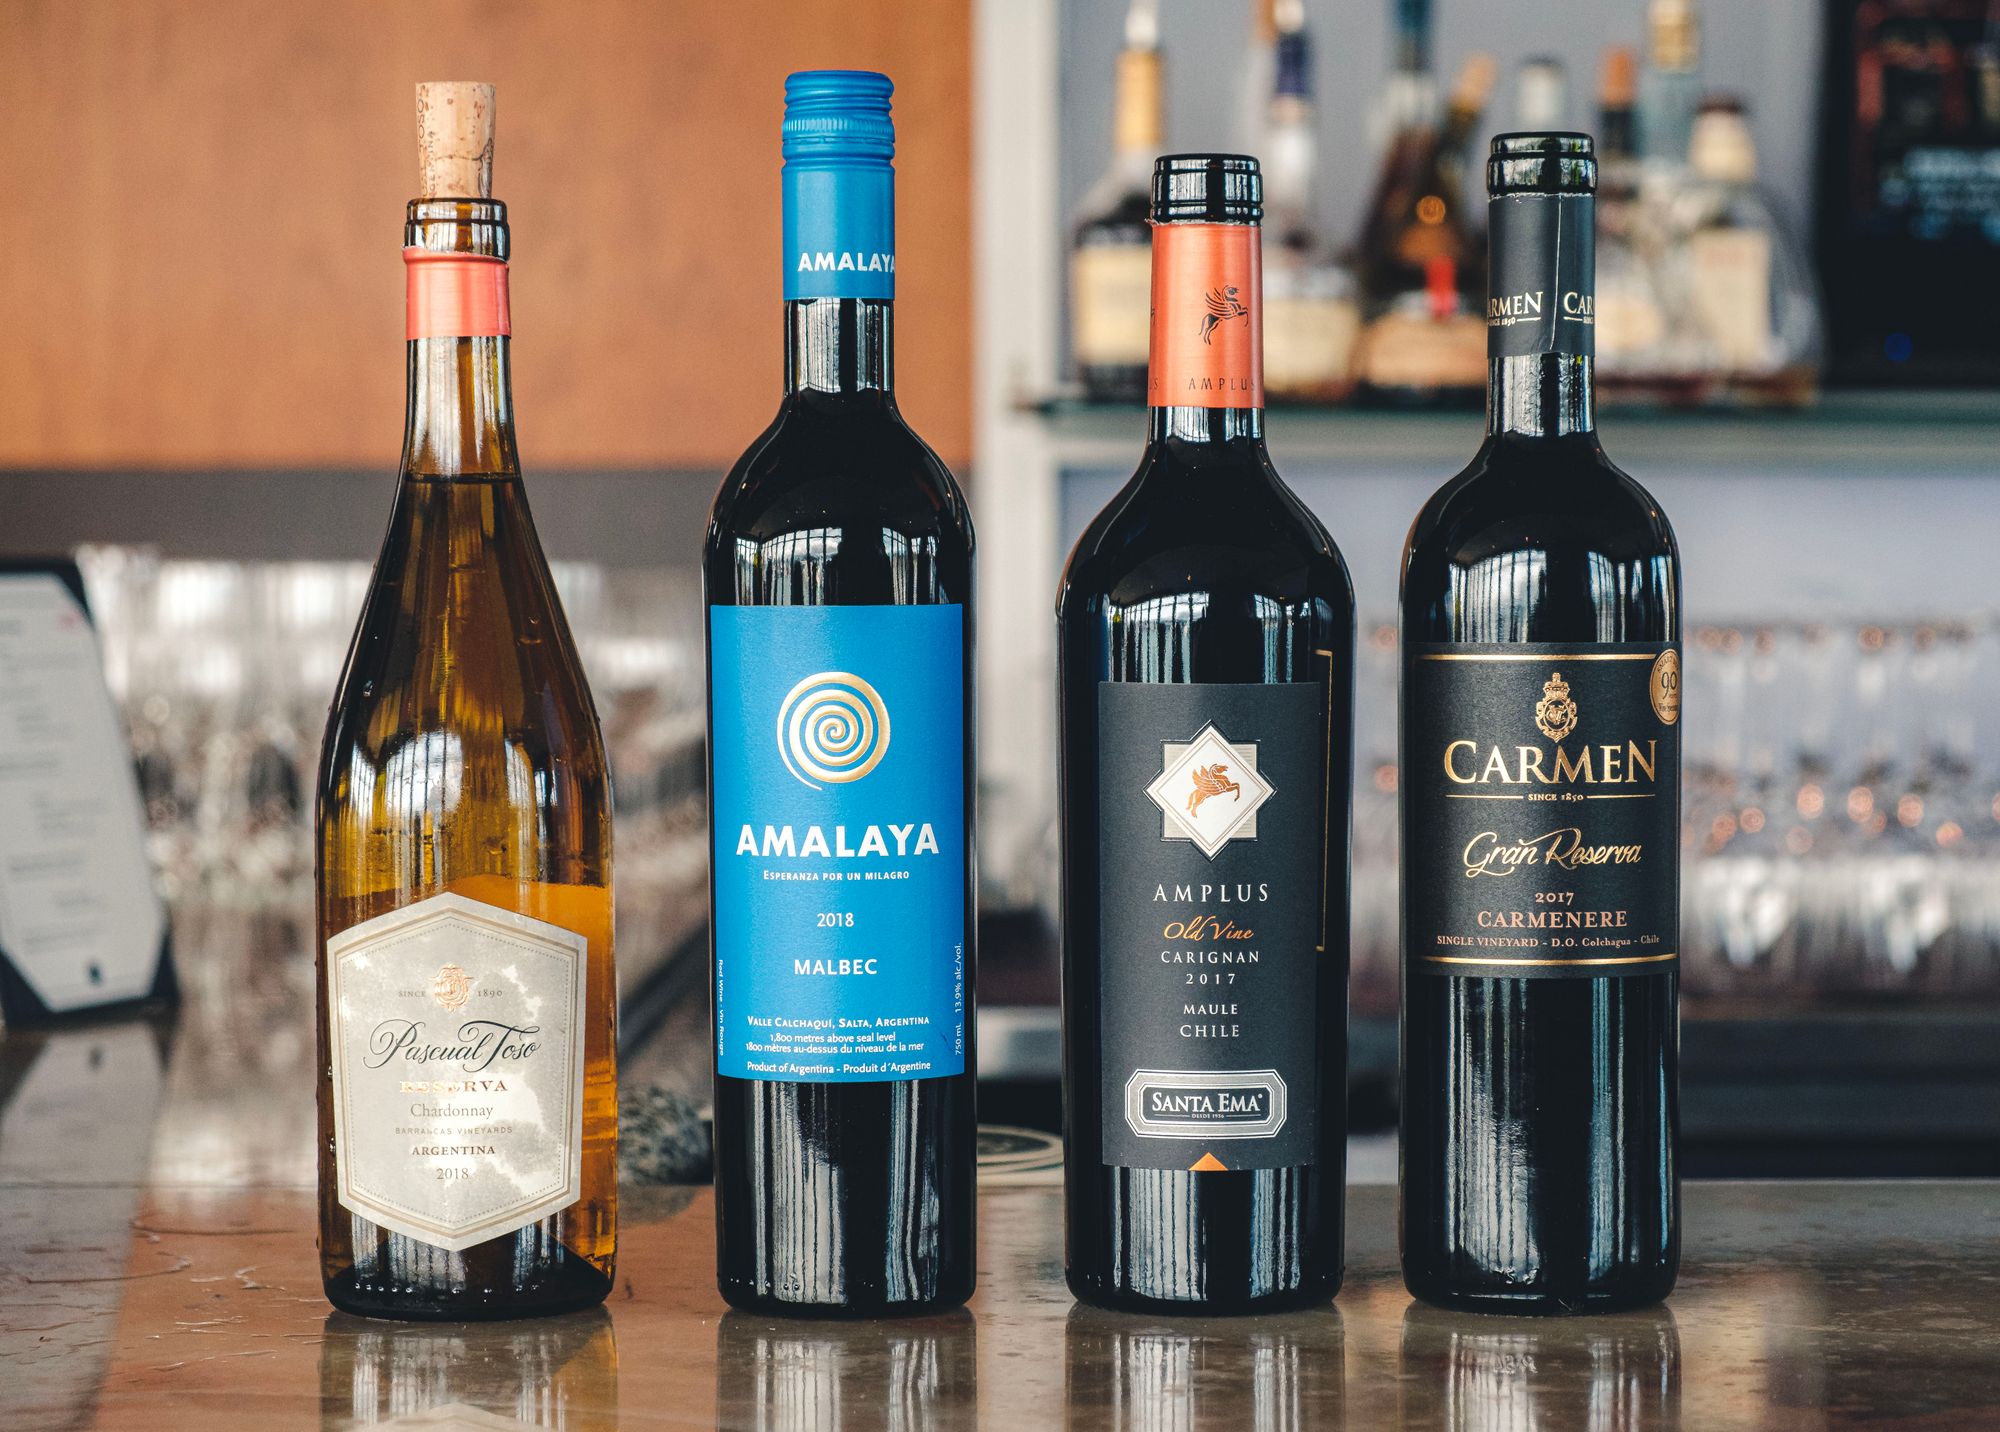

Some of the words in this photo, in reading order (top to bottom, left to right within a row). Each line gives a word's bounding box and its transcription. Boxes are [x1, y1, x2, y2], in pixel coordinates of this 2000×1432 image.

[798, 252, 895, 272] AMALAYA
[1661, 671, 1678, 699] 90
[1444, 739, 1657, 784] CARMEN
[1528, 793, 1557, 801] SINCE
[1561, 792, 1584, 802] 1850
[736, 823, 940, 858] AMALAYA
[1463, 831, 1538, 878] Gran
[1518, 827, 1642, 870] Reserva
[763, 869, 819, 881] ESPERANZA
[822, 872, 843, 881] POR
[847, 872, 861, 881] UN
[865, 871, 910, 881] MILAGRO
[1152, 883, 1268, 903] AMPLUS
[1535, 891, 1575, 906] 2017
[816, 912, 855, 928] 2018
[1477, 910, 1628, 929] CARMENERE
[1163, 915, 1216, 941] Old
[1209, 920, 1255, 941] Vine
[1436, 935, 1475, 946] SINGLE
[1476, 936, 1539, 948] VINEYARD
[1551, 938, 1578, 947] D.O.
[1581, 937, 1631, 949] Colchagua
[1640, 935, 1660, 945] Chile
[1161, 951, 1260, 964] CARIGNAN
[794, 958, 878, 975] MALBEC
[1185, 973, 1236, 985] 2017
[399, 990, 426, 998] SINCE
[477, 989, 503, 998] 1890
[954, 982, 962, 1013] 13.9%
[1183, 1003, 1239, 1015] MAULE
[747, 1016, 772, 1027] VALLE
[838, 1018, 873, 1029] SALTA,
[875, 1016, 930, 1027] ARGENTINA
[770, 1033, 792, 1043] 1,800
[794, 1034, 825, 1043] metres
[827, 1033, 854, 1043] above
[856, 1033, 874, 1042] seal
[876, 1032, 896, 1042] level
[1180, 1025, 1240, 1038] CHILE
[363, 1019, 494, 1069] Pascual
[457, 1020, 542, 1073] Toso
[745, 1042, 762, 1052] 1800
[764, 1043, 791, 1053] mètres
[793, 1044, 838, 1054] au-dessus
[840, 1044, 852, 1054] du
[855, 1044, 884, 1053] niveau
[886, 1042, 897, 1052] de
[899, 1042, 907, 1052] la
[908, 1043, 924, 1051] mer
[747, 1061, 777, 1072] Product
[778, 1062, 788, 1072] of
[789, 1063, 834, 1075] Argentina
[843, 1063, 878, 1074] Produit
[1152, 1092, 1214, 1112] SANTA
[1218, 1093, 1261, 1112] EMA
[410, 1103, 494, 1119] Chardonnay
[457, 1126, 513, 1135] VINEYARDS
[412, 1145, 496, 1155] ARGENTINA
[436, 1167, 469, 1180] 2018
